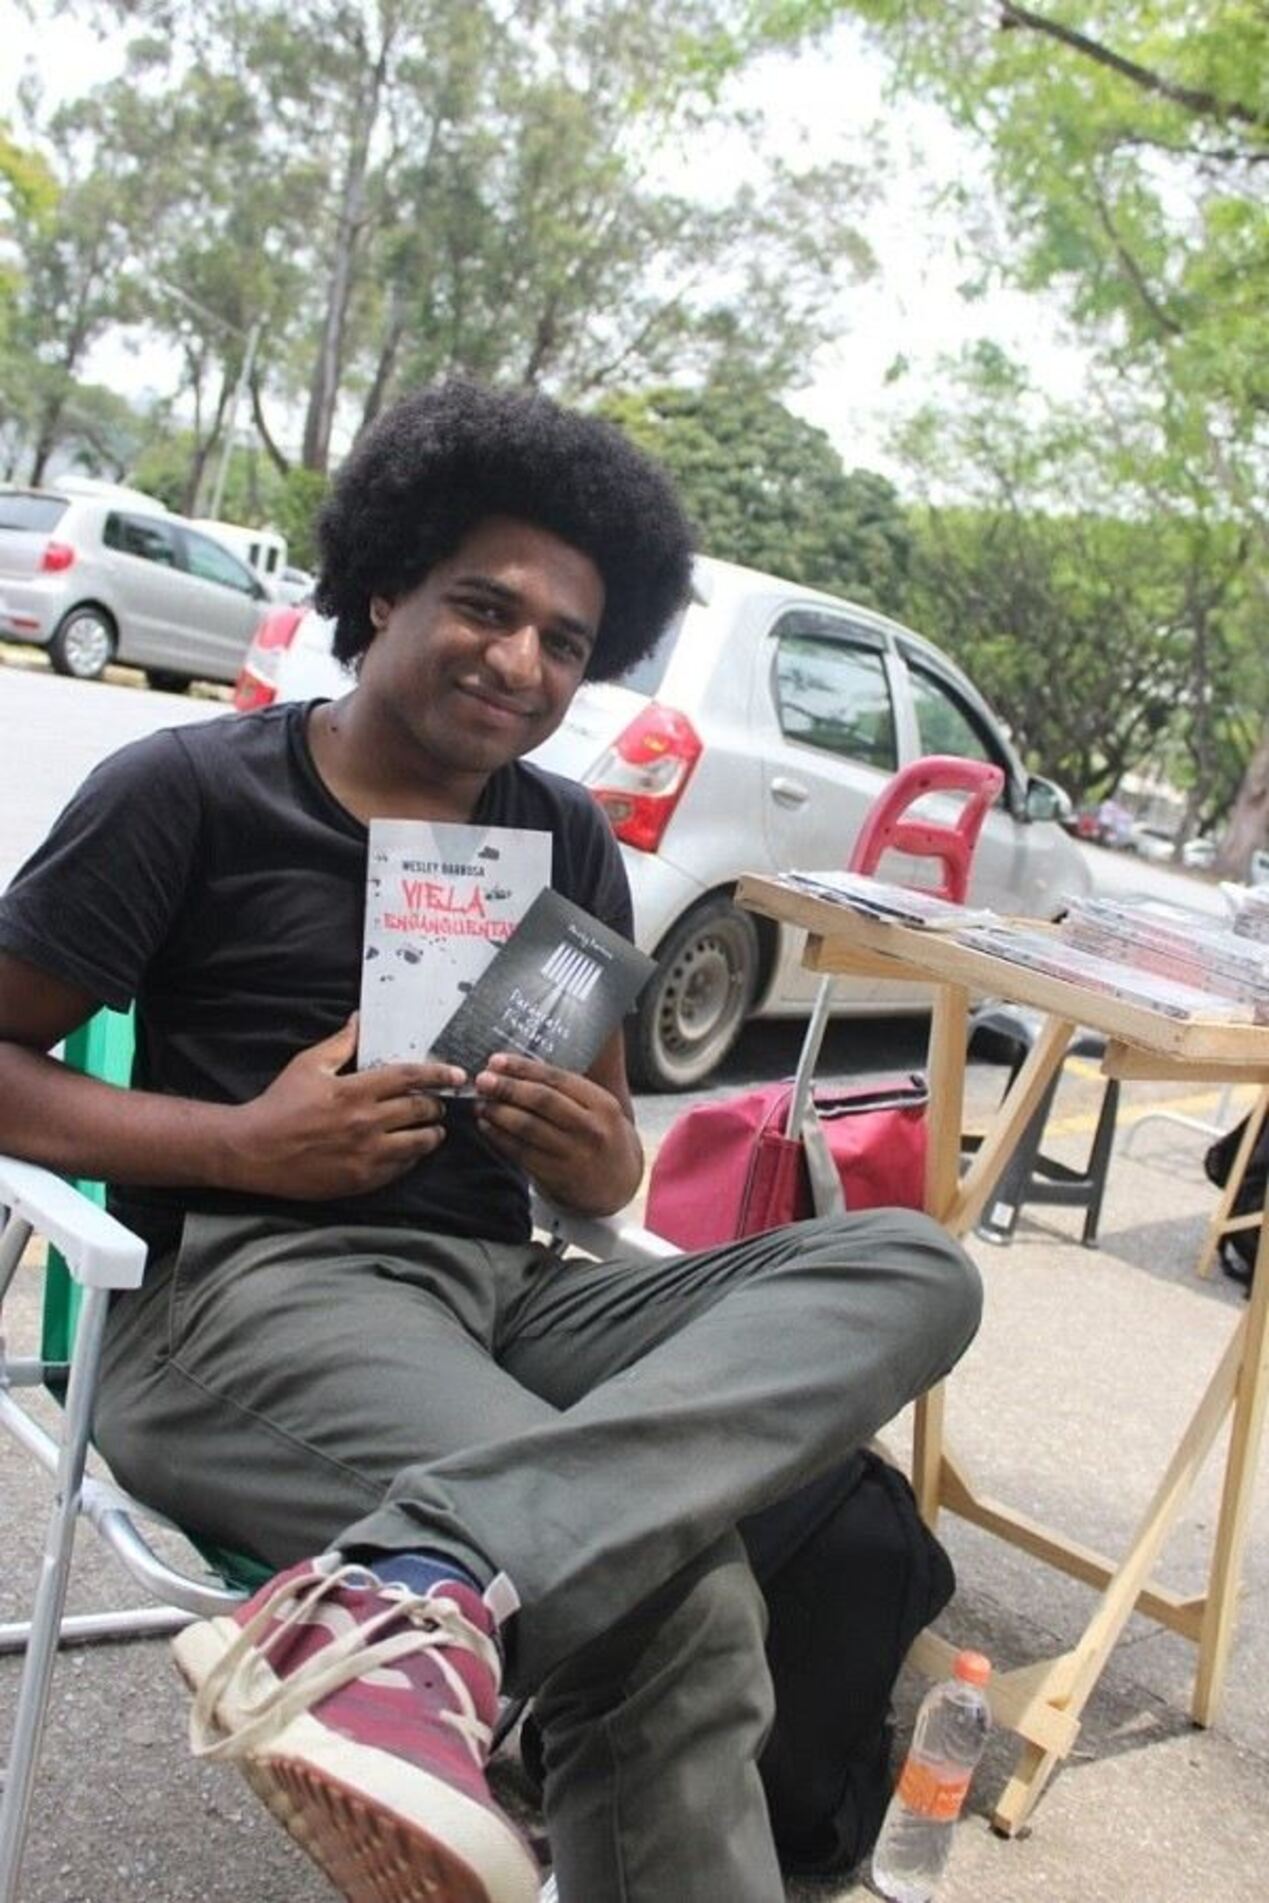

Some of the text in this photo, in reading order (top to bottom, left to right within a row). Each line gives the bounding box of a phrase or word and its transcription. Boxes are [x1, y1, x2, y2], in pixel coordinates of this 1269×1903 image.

[402, 860, 485, 876] WESLEY BARBOSA
[402, 879, 486, 918] VIELA
